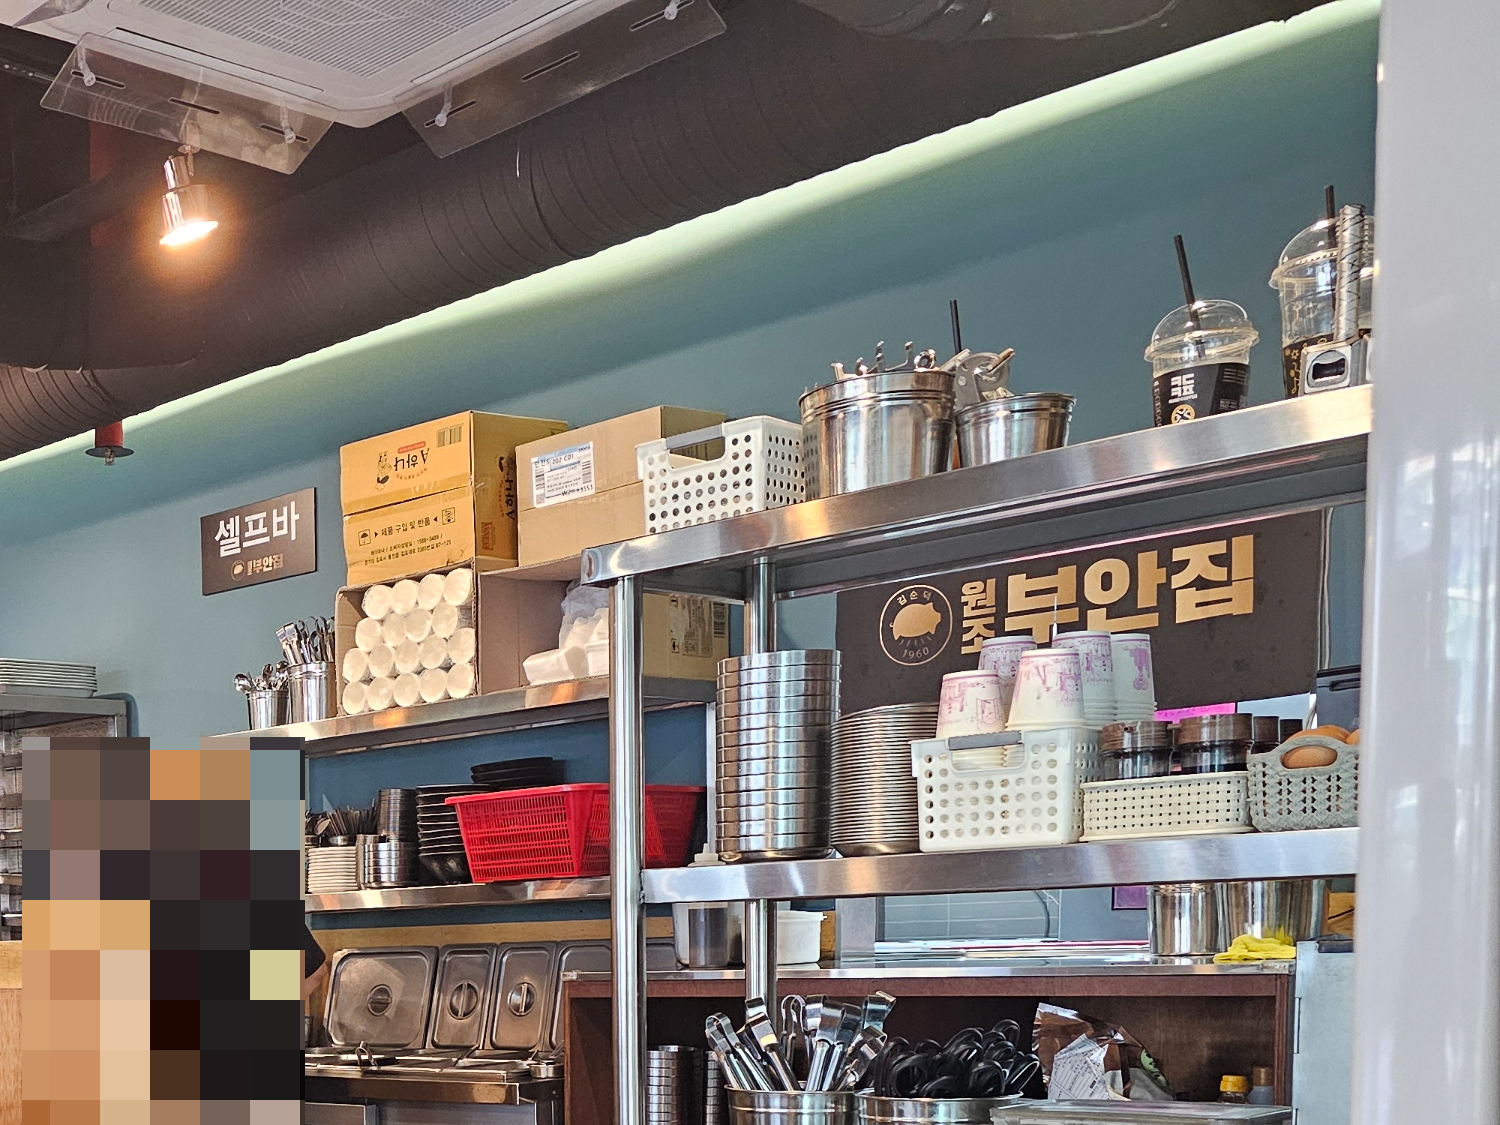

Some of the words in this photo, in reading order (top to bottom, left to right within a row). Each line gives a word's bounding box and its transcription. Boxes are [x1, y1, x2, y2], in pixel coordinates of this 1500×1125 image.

[214, 501, 300, 558] 셀프바
[381, 527, 394, 537] 제품
[395, 523, 409, 534] 구입
[418, 516, 432, 528] 반품
[1003, 534, 1255, 645] 부안집
[901, 645, 932, 660] 1960
